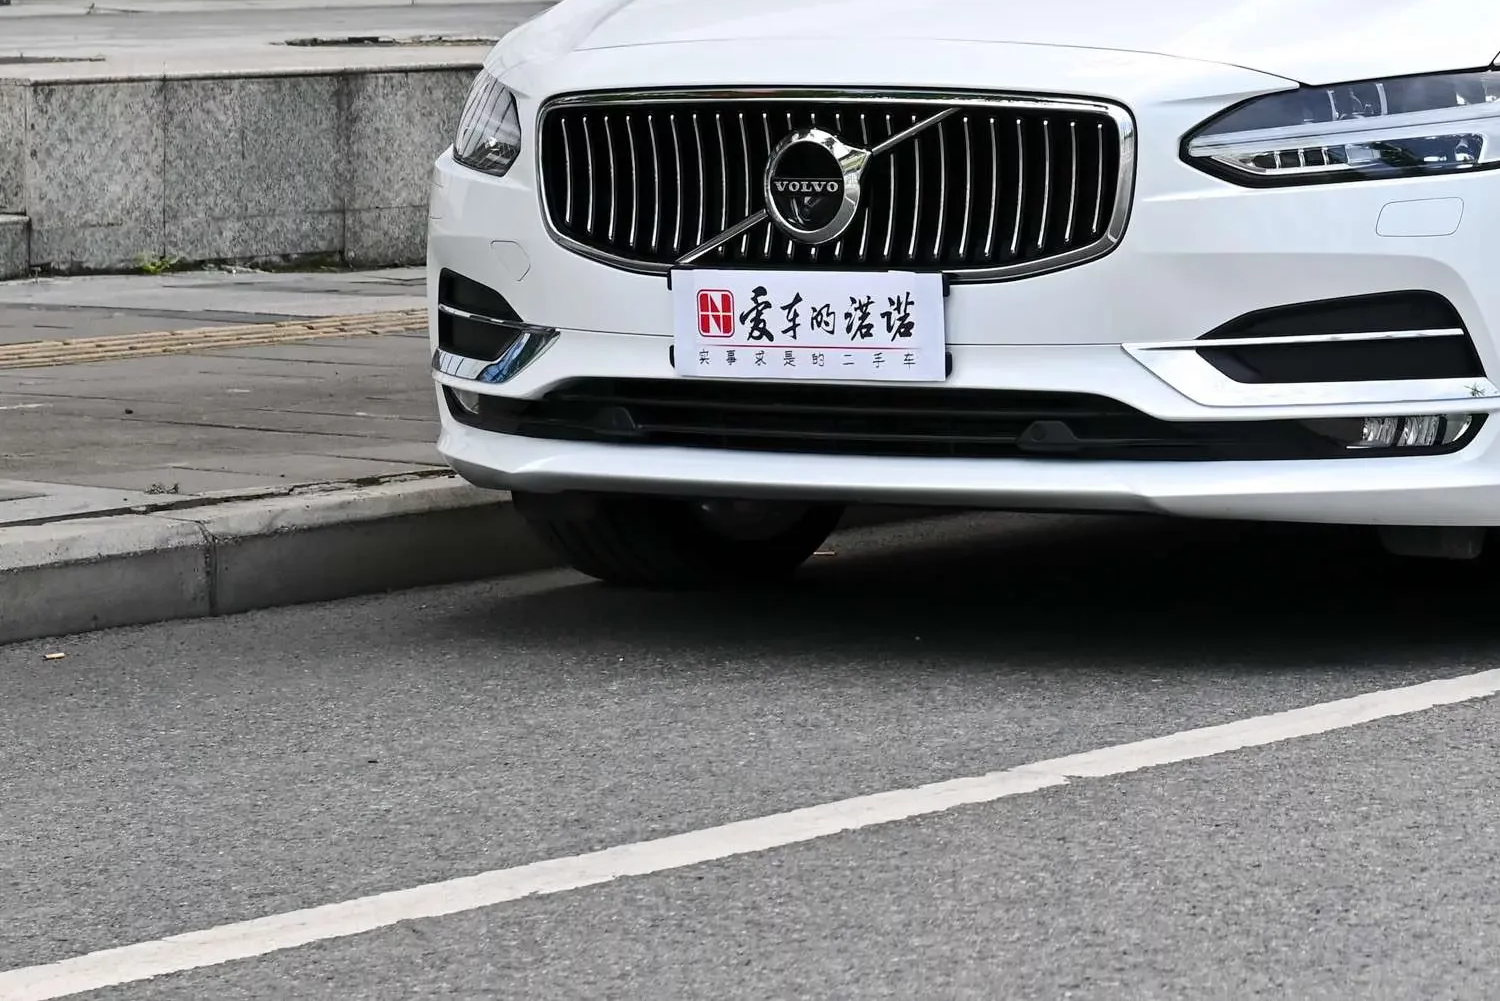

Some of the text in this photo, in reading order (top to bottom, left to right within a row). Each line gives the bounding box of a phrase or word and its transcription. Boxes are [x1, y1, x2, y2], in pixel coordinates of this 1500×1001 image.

[773, 180, 839, 193] VOLVO
[699, 348, 916, 370] 实事求是的二手车
